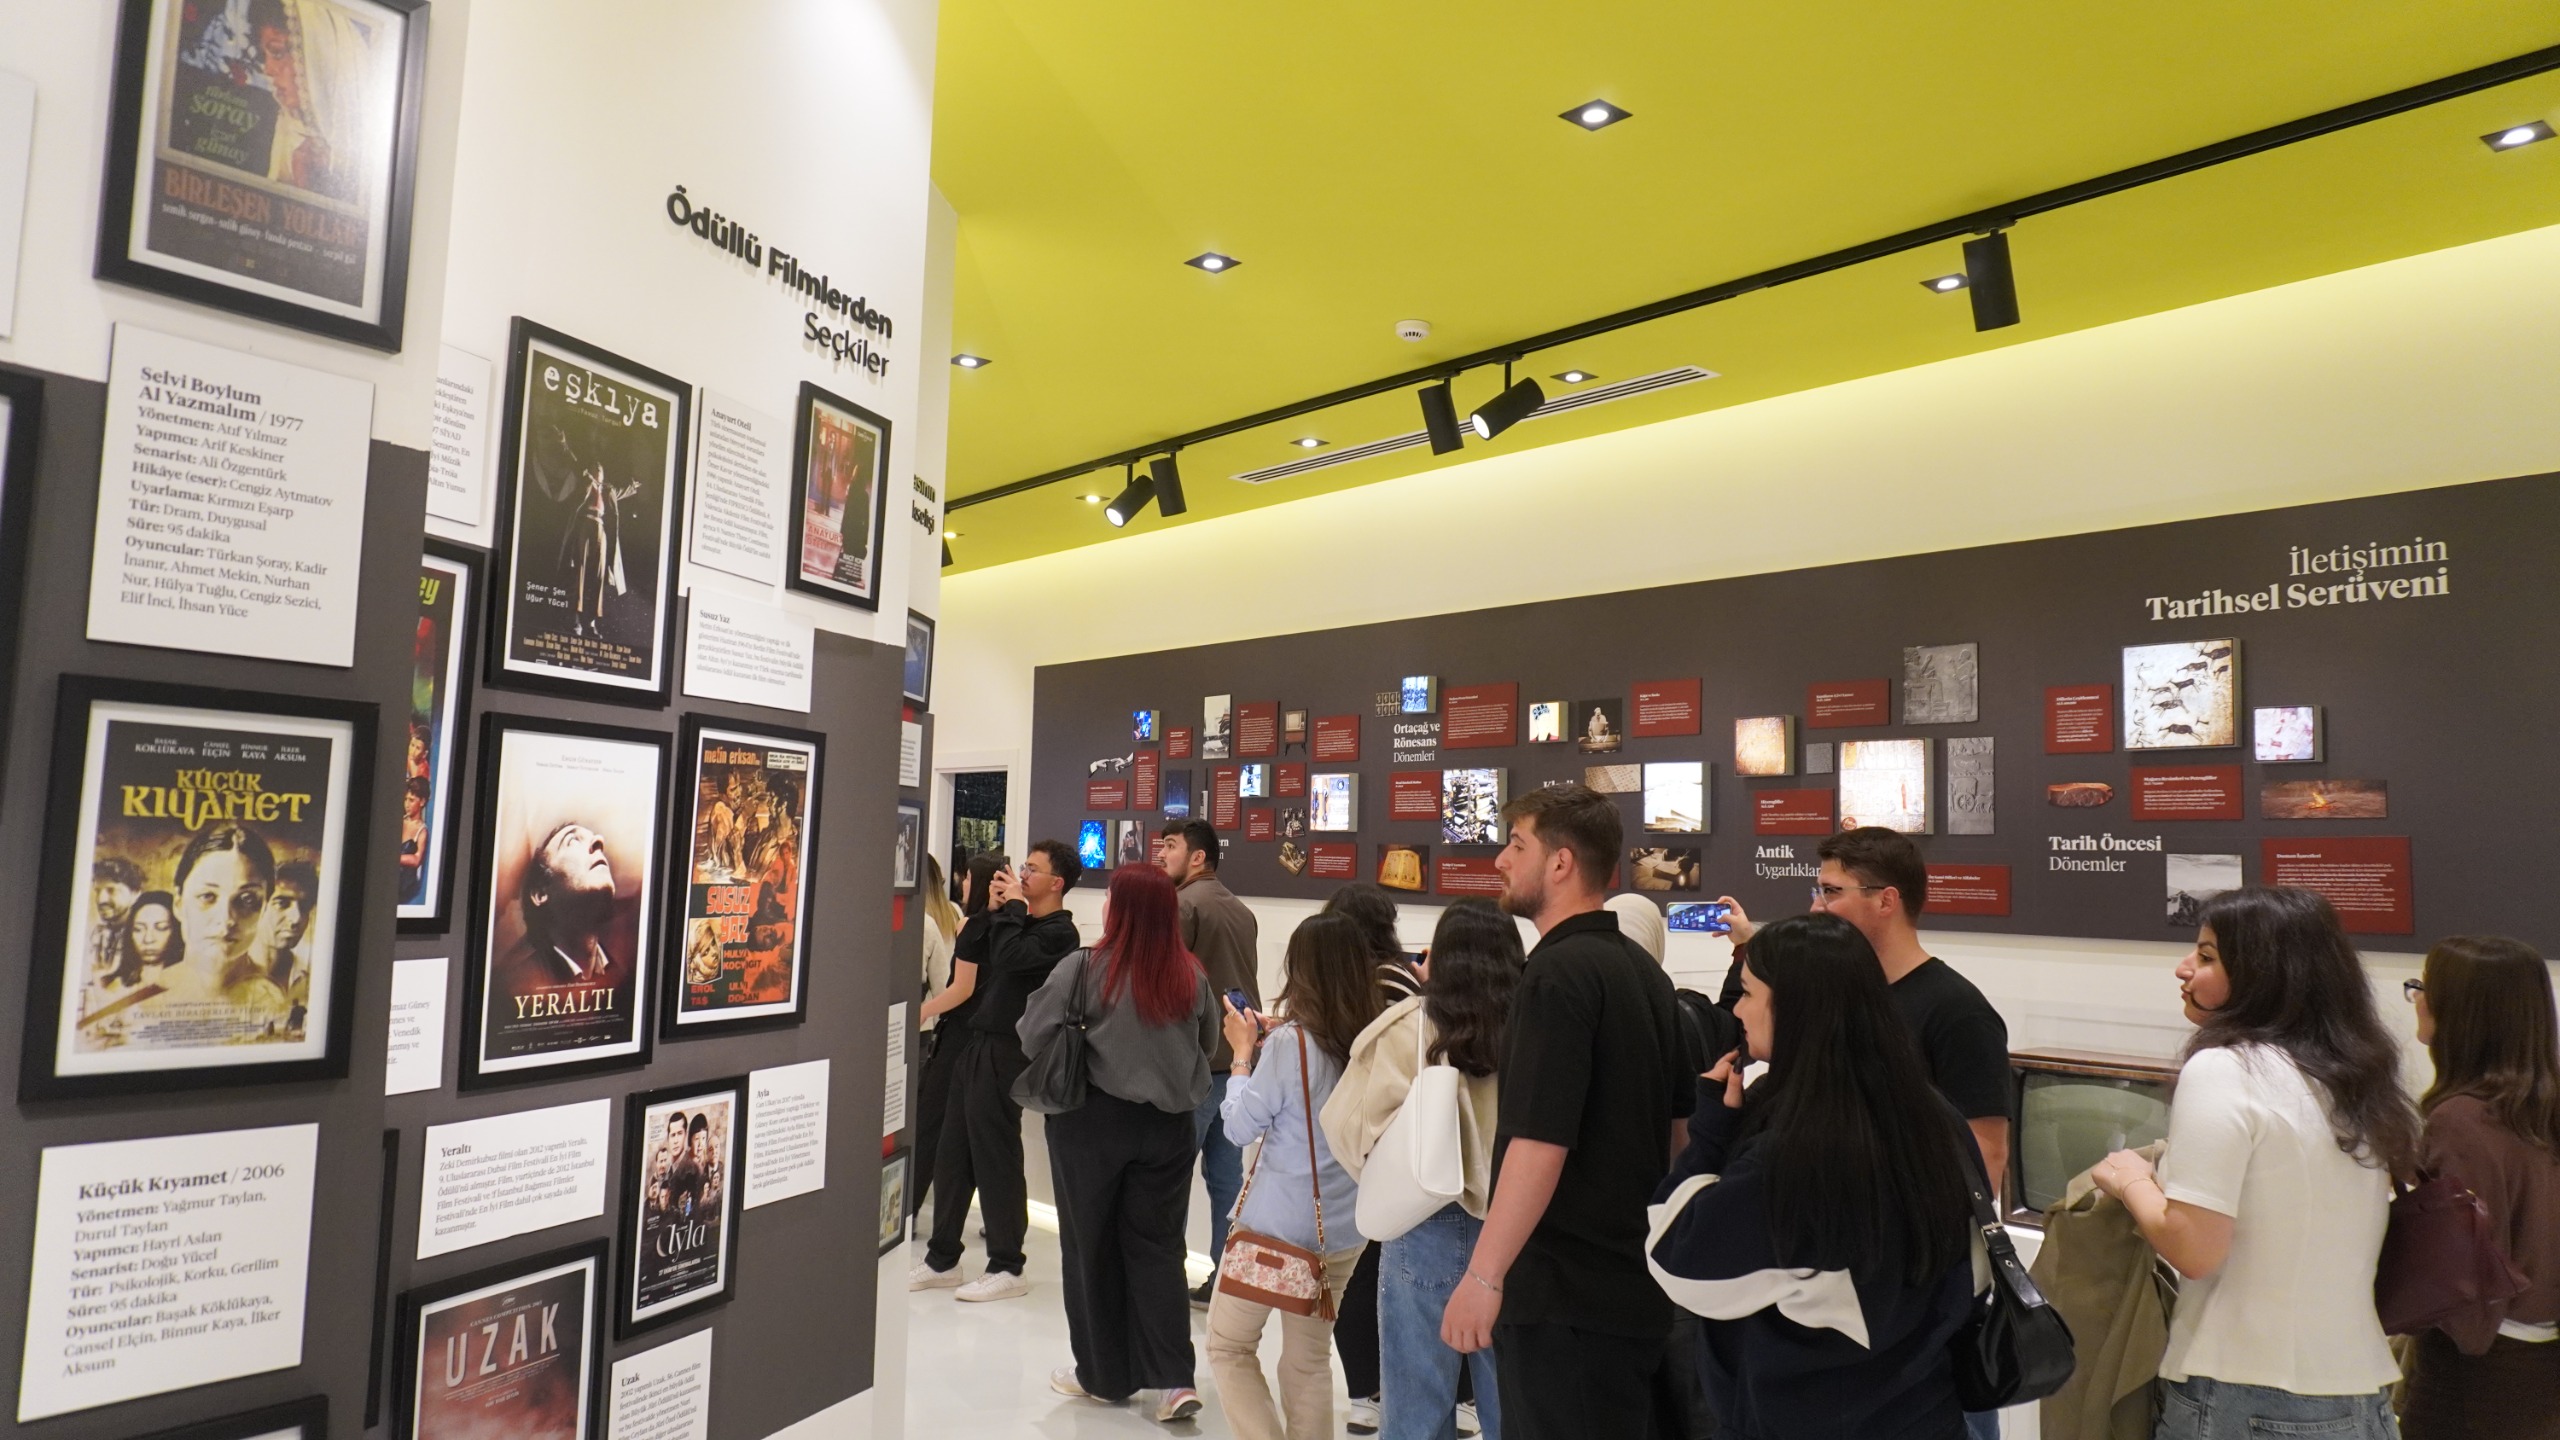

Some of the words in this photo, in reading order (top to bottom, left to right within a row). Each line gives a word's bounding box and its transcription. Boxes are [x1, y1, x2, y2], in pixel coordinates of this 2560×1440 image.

[666, 185, 762, 268] Ödüllü
[769, 247, 892, 339] Filmlerden
[804, 312, 889, 377] Seçkiler
[141, 366, 187, 390] Selvi
[190, 378, 262, 405] Boylum
[139, 386, 160, 401] Al
[165, 390, 256, 422] Yazmalım
[270, 414, 303, 431] 1977
[711, 408, 736, 425] Anayurt
[138, 406, 214, 432] Yönetmen:
[217, 422, 242, 437] Atıf
[245, 427, 287, 446] Yılmaz
[136, 424, 198, 447] Yapımcı:
[201, 437, 226, 451] Arif
[229, 442, 284, 463] Keskiner
[134, 443, 196, 464] Senarist:
[200, 455, 218, 468] Ali
[221, 457, 287, 481] Özgentürk
[133, 461, 182, 483] Hikâye
[185, 471, 227, 490] (eser):
[230, 478, 272, 497] Cengiz
[275, 486, 333, 507] Aytmatov
[129, 498, 160, 513] Tür:
[164, 504, 204, 521] Dram,
[207, 512, 267, 531] Duygusal
[131, 480, 204, 503] Uyarlama:
[207, 493, 255, 511] Kırmızı
[258, 501, 294, 519] Eşarp
[127, 517, 164, 533] Süre:
[167, 523, 183, 536] 95
[186, 526, 230, 543] dakika
[125, 536, 204, 557] Oyuncular:
[207, 547, 253, 564] Türkan
[256, 556, 291, 573] Şoray,
[295, 561, 328, 575] Kadir
[2289, 536, 2448, 577] İletişimin
[124, 553, 168, 572] İnanır,
[171, 560, 215, 577] Ahmet
[218, 568, 261, 584] Mekin,
[264, 574, 310, 591] Nurhan
[122, 573, 150, 588] Nur,
[154, 577, 192, 594] Hülya
[196, 582, 237, 599] Tuğlu,
[240, 589, 282, 605] Cengiz
[284, 594, 321, 610] Sezici,
[526, 594, 543, 603] Uğur
[548, 598, 568, 608] Yücel
[527, 581, 548, 592] Şener
[553, 587, 566, 596] Şen
[2146, 583, 2281, 620] Tarihsel
[2287, 567, 2450, 609] Serüveni
[121, 591, 144, 605] Elif
[147, 593, 175, 609] İnci,
[178, 598, 215, 614] İhsan
[218, 603, 248, 618] Yüce
[700, 610, 718, 621] Susuz
[720, 614, 730, 623] Yaz
[1393, 737, 1437, 748] Rönesans
[1394, 722, 1428, 735] Ortaçağ
[1430, 723, 1440, 731] ve
[242, 751, 266, 760] KAYA
[274, 753, 306, 762] AKSUM
[1393, 750, 1435, 762] Dönemleri
[1756, 845, 1794, 858] Antik
[2049, 836, 2098, 851] Tarih
[2100, 833, 2162, 851] Öncesi
[1756, 863, 1821, 879] Uygarlıklar
[2049, 855, 2126, 872] Dönemler
[707, 886, 750, 915] SUSUZ
[720, 916, 750, 944] YAZ
[515, 988, 614, 1019] YERALTI
[757, 1089, 770, 1099] Ayla
[441, 1144, 471, 1157] Yeraltı
[78, 1177, 143, 1201] Küçük
[148, 1170, 228, 1193] Kıyamet
[242, 1163, 285, 1182] 2006
[78, 1204, 159, 1224] Yönetmen:
[162, 1196, 215, 1215] Yağmur
[219, 1191, 267, 1208] Taylan,
[74, 1226, 117, 1242] Durul
[120, 1221, 168, 1238] Taylan
[142, 1238, 181, 1254] Hayri
[184, 1231, 222, 1248] Aslan
[69, 1285, 102, 1300] Tür:
[184, 1267, 228, 1284] Korku,
[231, 1258, 279, 1276] Gerilim
[71, 1262, 138, 1280] Senarist:
[141, 1255, 178, 1274] Doğu
[181, 1248, 218, 1266] Yücel
[66, 1315, 151, 1340] Oyuncular:
[156, 1304, 197, 1324] Başak
[201, 1293, 272, 1317] Köklükaya,
[67, 1303, 107, 1320] Süre:
[110, 1297, 127, 1312] 95
[131, 1291, 177, 1309] dakika
[64, 1340, 114, 1358] Cansel
[118, 1330, 157, 1349] Elçin,
[161, 1322, 208, 1340] Binnur
[211, 1316, 248, 1334] Kaya,
[250, 1310, 281, 1326] İlker
[446, 1302, 559, 1388] UZAK
[62, 1356, 116, 1378] Aksum
[621, 1372, 640, 1387] Uzak
